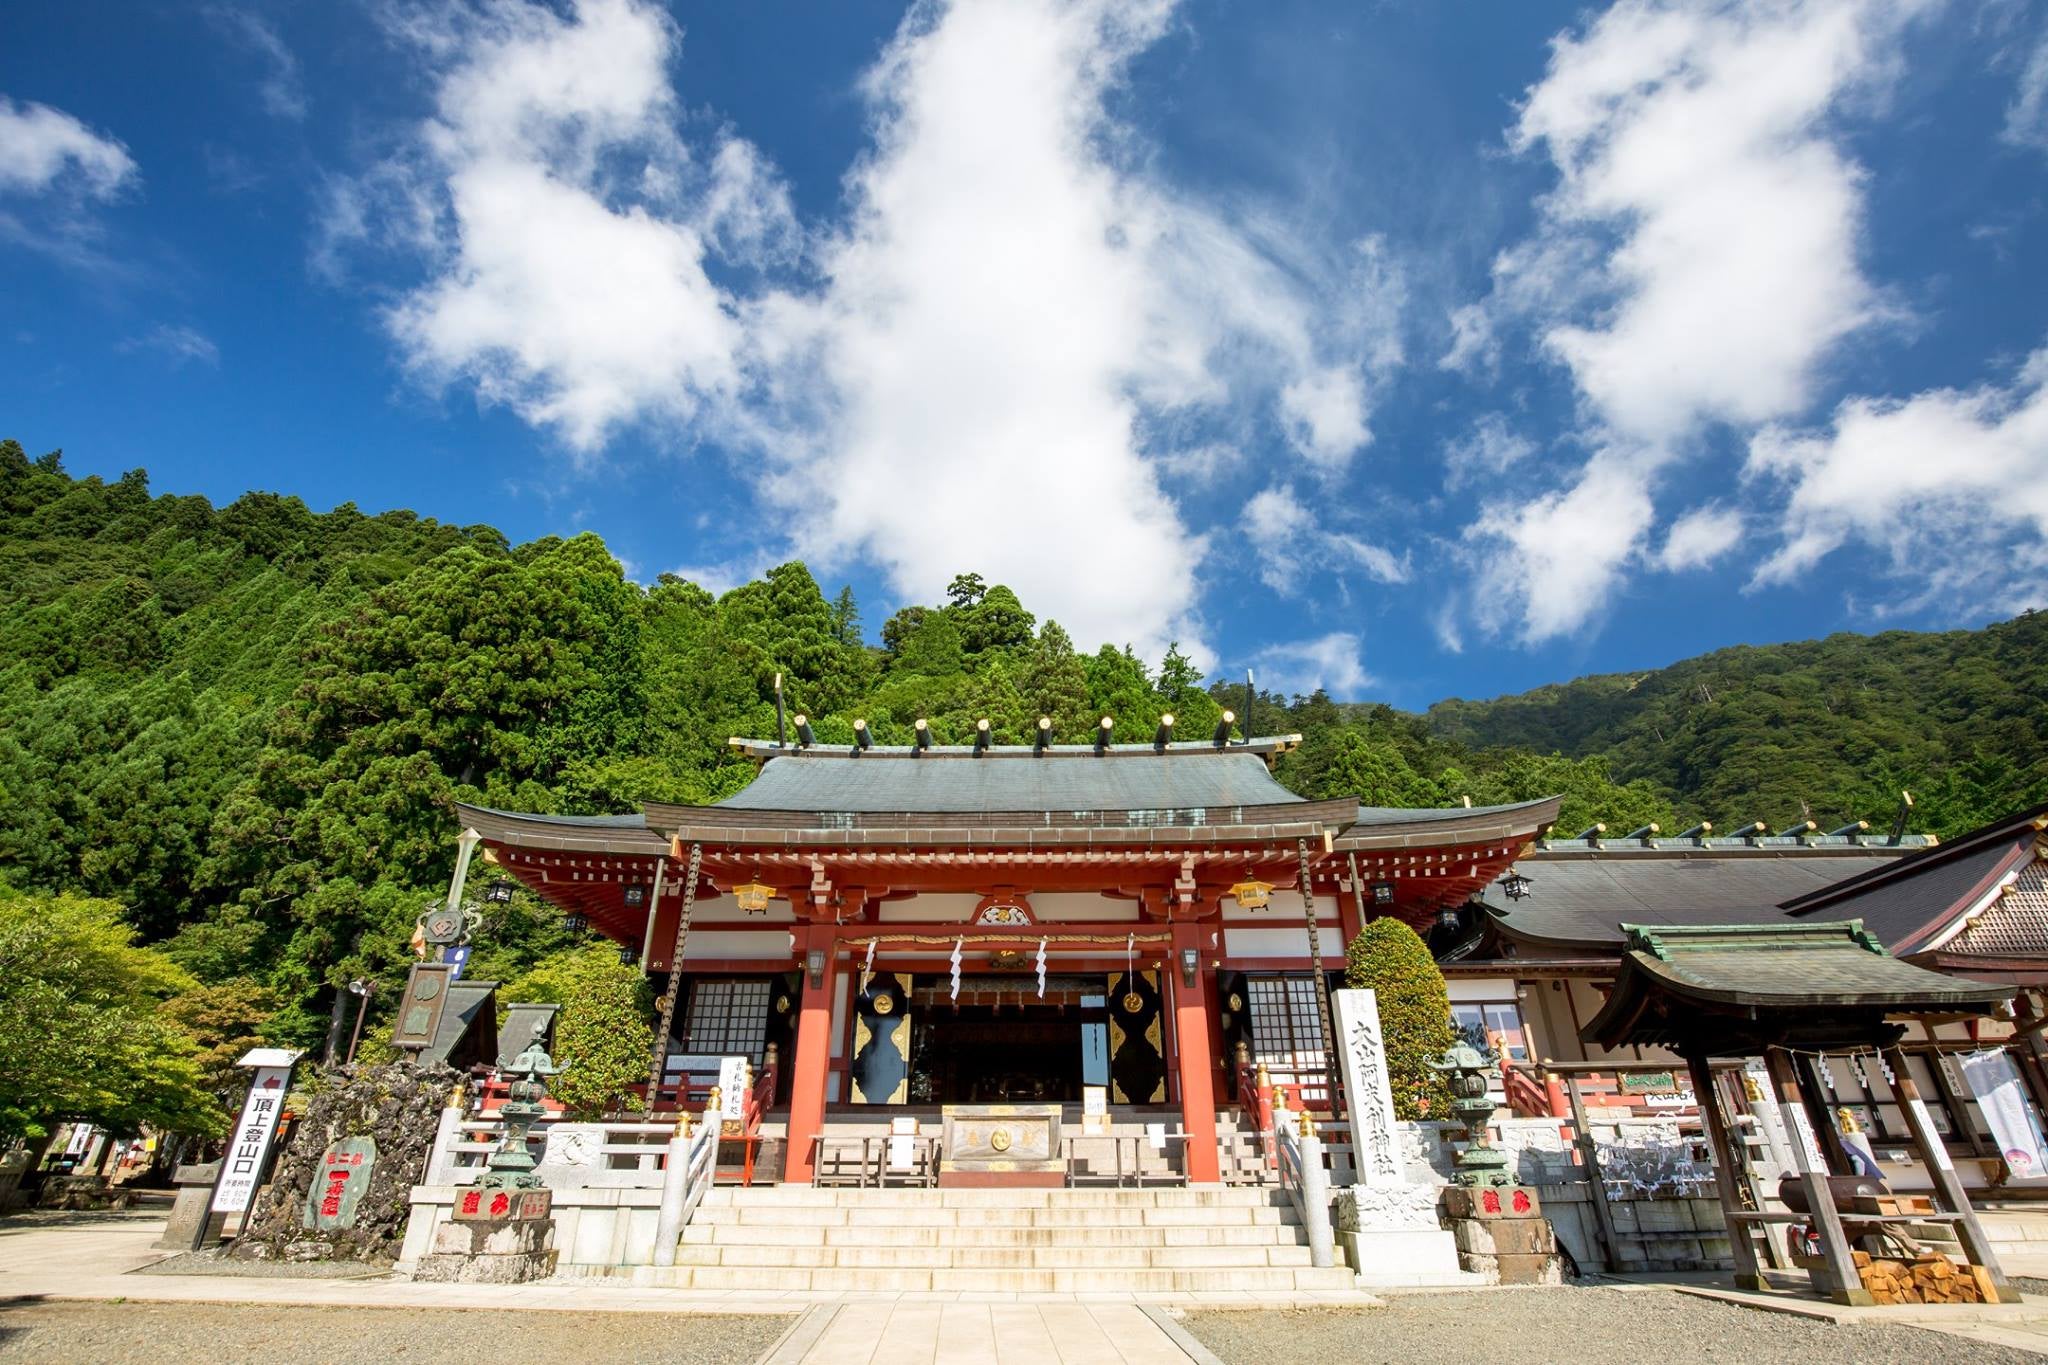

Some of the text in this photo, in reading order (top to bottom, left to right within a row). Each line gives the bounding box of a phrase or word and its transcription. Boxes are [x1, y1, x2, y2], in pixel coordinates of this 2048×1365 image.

[233, 1097, 276, 1175] 頂上登山口
